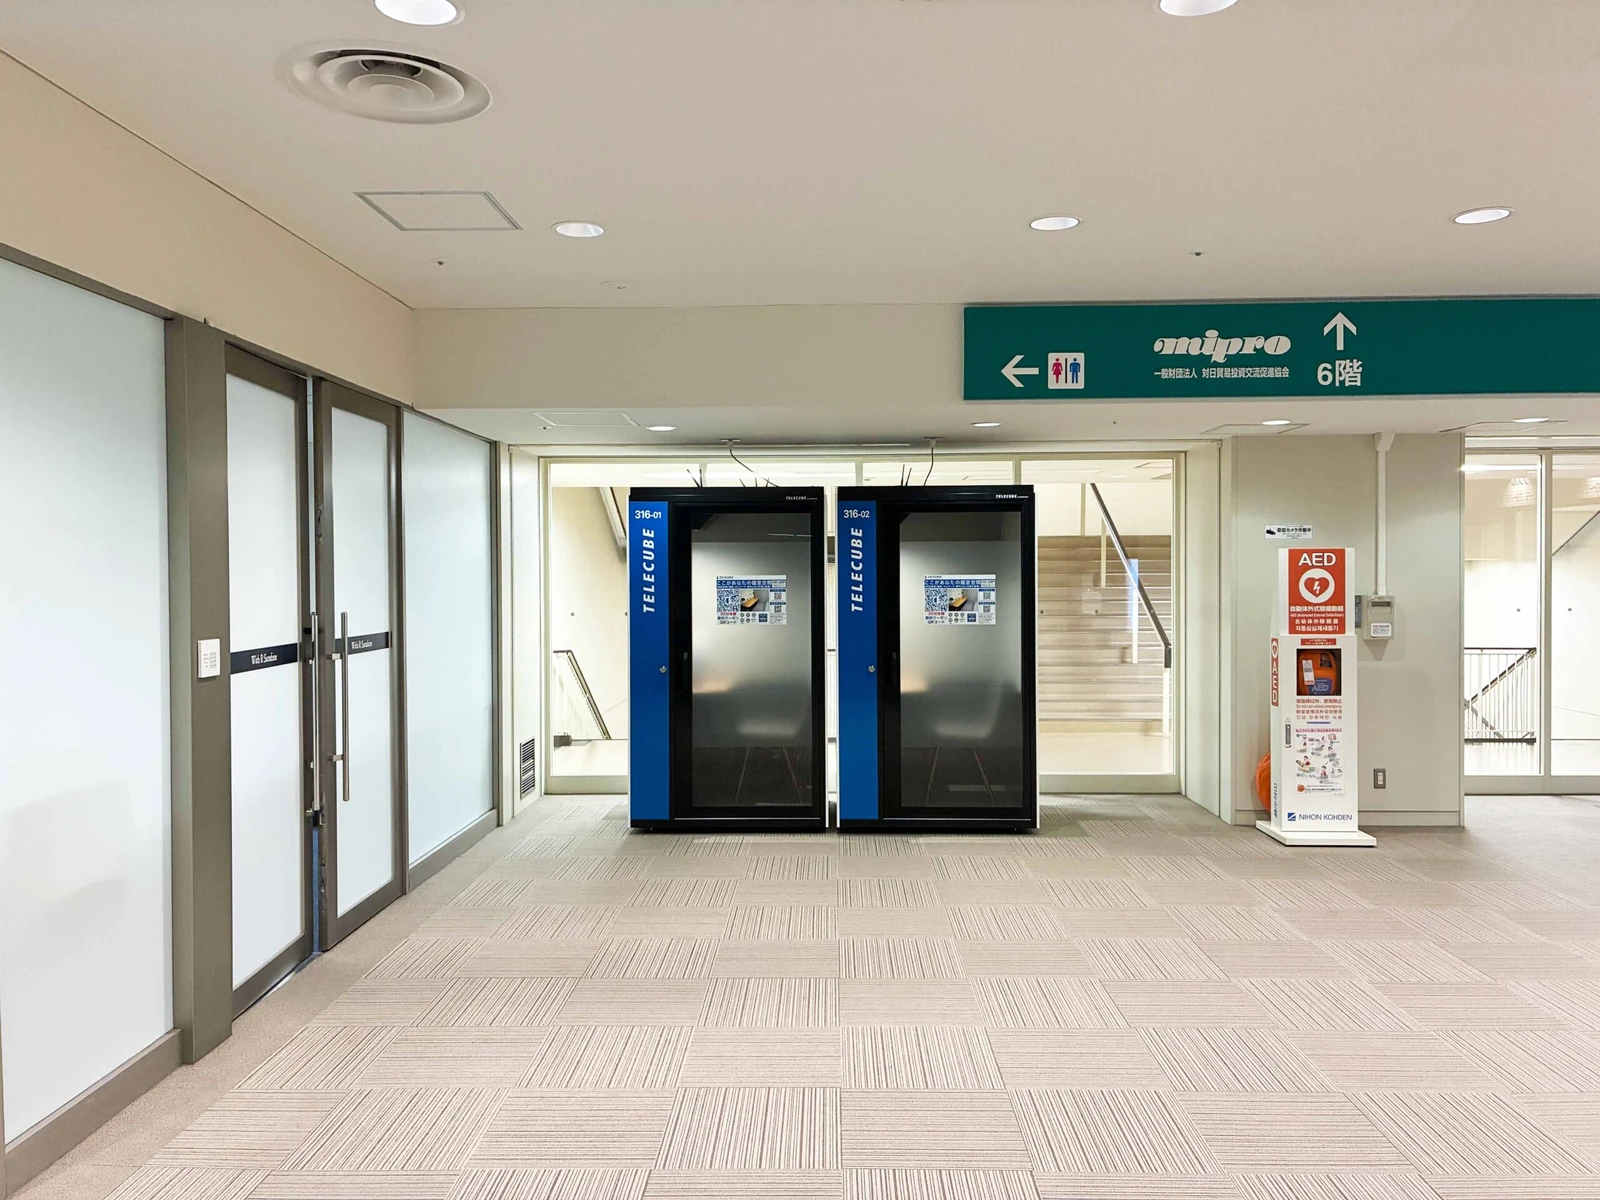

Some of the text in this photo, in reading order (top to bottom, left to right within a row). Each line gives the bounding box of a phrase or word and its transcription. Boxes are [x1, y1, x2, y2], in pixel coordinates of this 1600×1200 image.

[1153, 329, 1291, 363] mipro
[1154, 367, 1290, 379] 一般財団法人 対日貿易投資交流促進協会
[1316, 359, 1363, 387] 6階
[634, 510, 662, 519] 316-01
[843, 509, 870, 519] 316-02
[851, 527, 863, 612] TELECUBE
[1298, 552, 1336, 566] AED
[642, 528, 655, 613] TELECUBE
